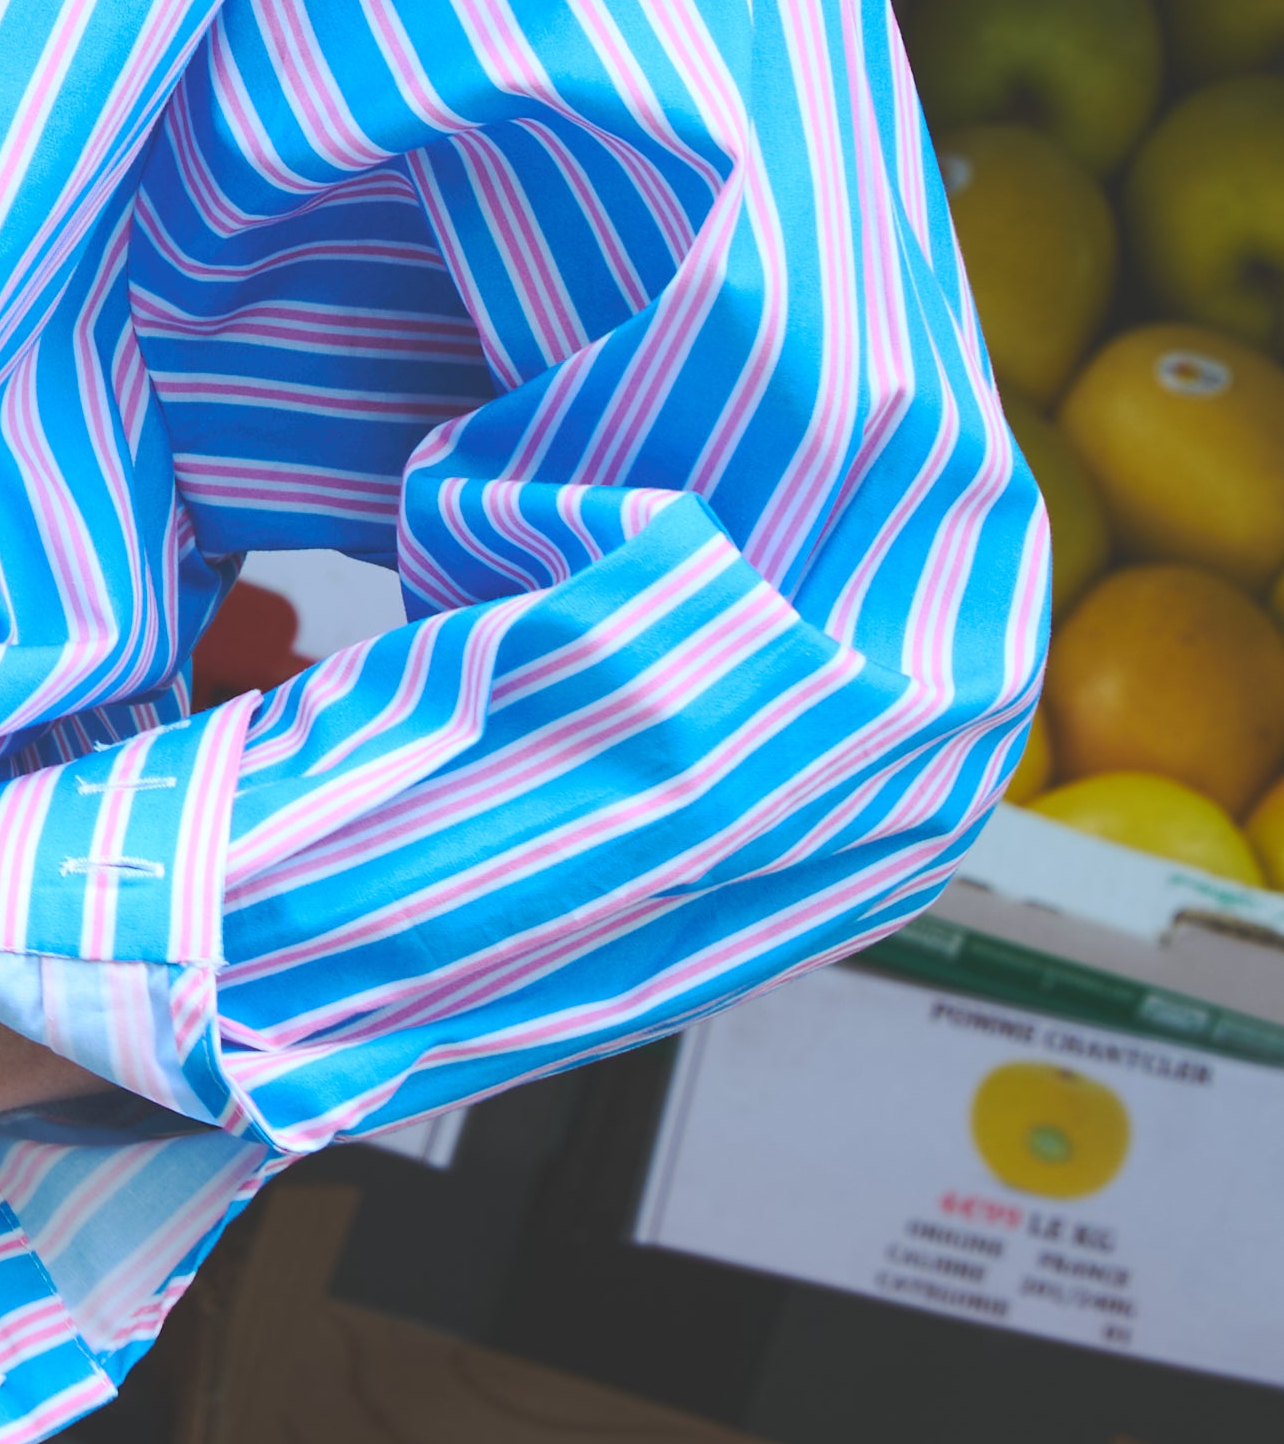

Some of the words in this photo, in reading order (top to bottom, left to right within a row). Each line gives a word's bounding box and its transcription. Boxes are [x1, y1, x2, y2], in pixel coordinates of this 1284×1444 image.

[932, 1002, 1032, 1045] POMME
[1030, 1212, 1063, 1239] LE
[1075, 1224, 1114, 1251] KG
